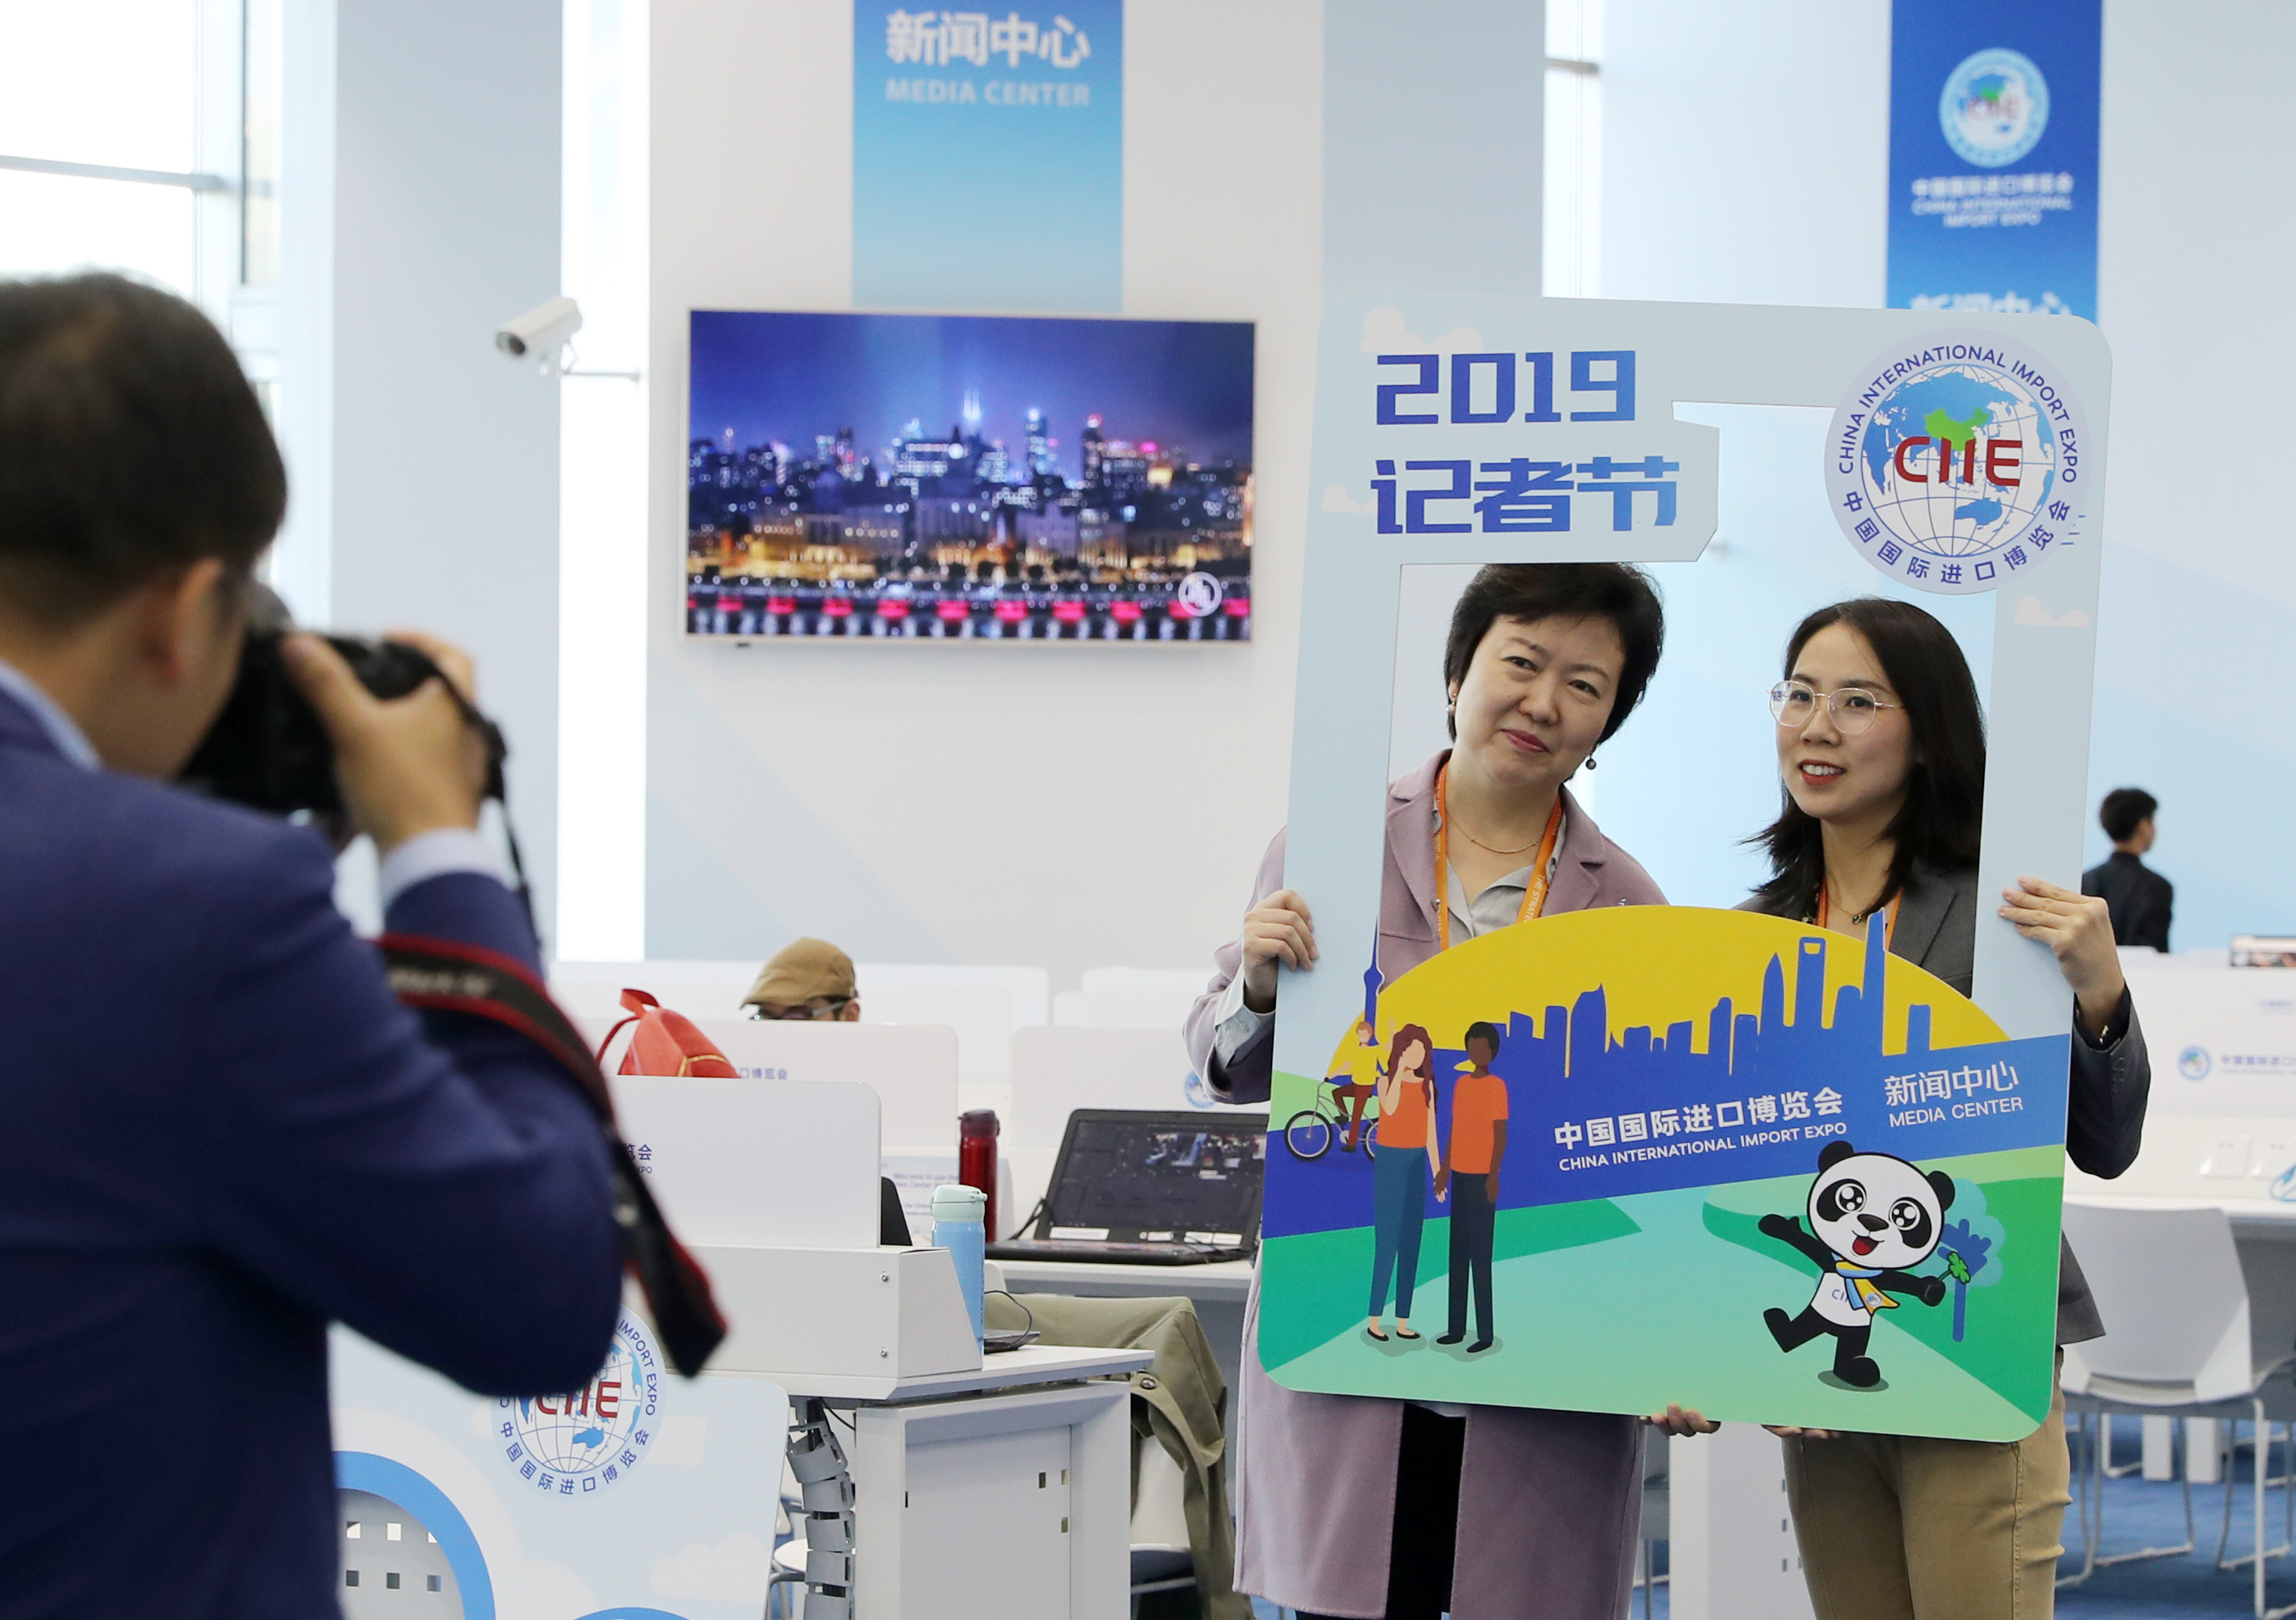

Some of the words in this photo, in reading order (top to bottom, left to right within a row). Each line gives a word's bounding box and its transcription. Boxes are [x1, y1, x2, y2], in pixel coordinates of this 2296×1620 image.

[885, 9, 1090, 68] 新闻中心
[885, 79, 977, 104] MEDIA
[983, 80, 1090, 106] CENTER
[1377, 350, 1636, 425] 2019
[1839, 412, 1866, 473] CHINA
[1858, 345, 2006, 409] INTERNATIONAL
[2011, 360, 2070, 423] IMPORT
[2059, 429, 2078, 483] EXPO
[1894, 436, 2022, 487] CIIE
[1370, 455, 1680, 535] 记者节
[1843, 491, 2070, 584] 中国国际进口博览会
[1523, 890, 1540, 922] STRATE
[1534, 874, 1546, 892] THE
[1883, 1061, 2019, 1107] 新闻中心
[1889, 1107, 1946, 1127] MEDIA
[1951, 1096, 2024, 1119] CENTER
[1554, 1086, 1843, 1150] 中国国际进口博览会
[1559, 1154, 1609, 1172] CHINA
[1612, 1136, 1737, 1165] INTERNATIONAL
[1740, 1127, 1800, 1147] IMPORT
[1804, 1122, 1847, 1140] EXPO
[618, 1319, 654, 1368] IMPORT
[645, 1372, 657, 1416] EXPO
[500, 1421, 649, 1495] 中国国际进口博览会
